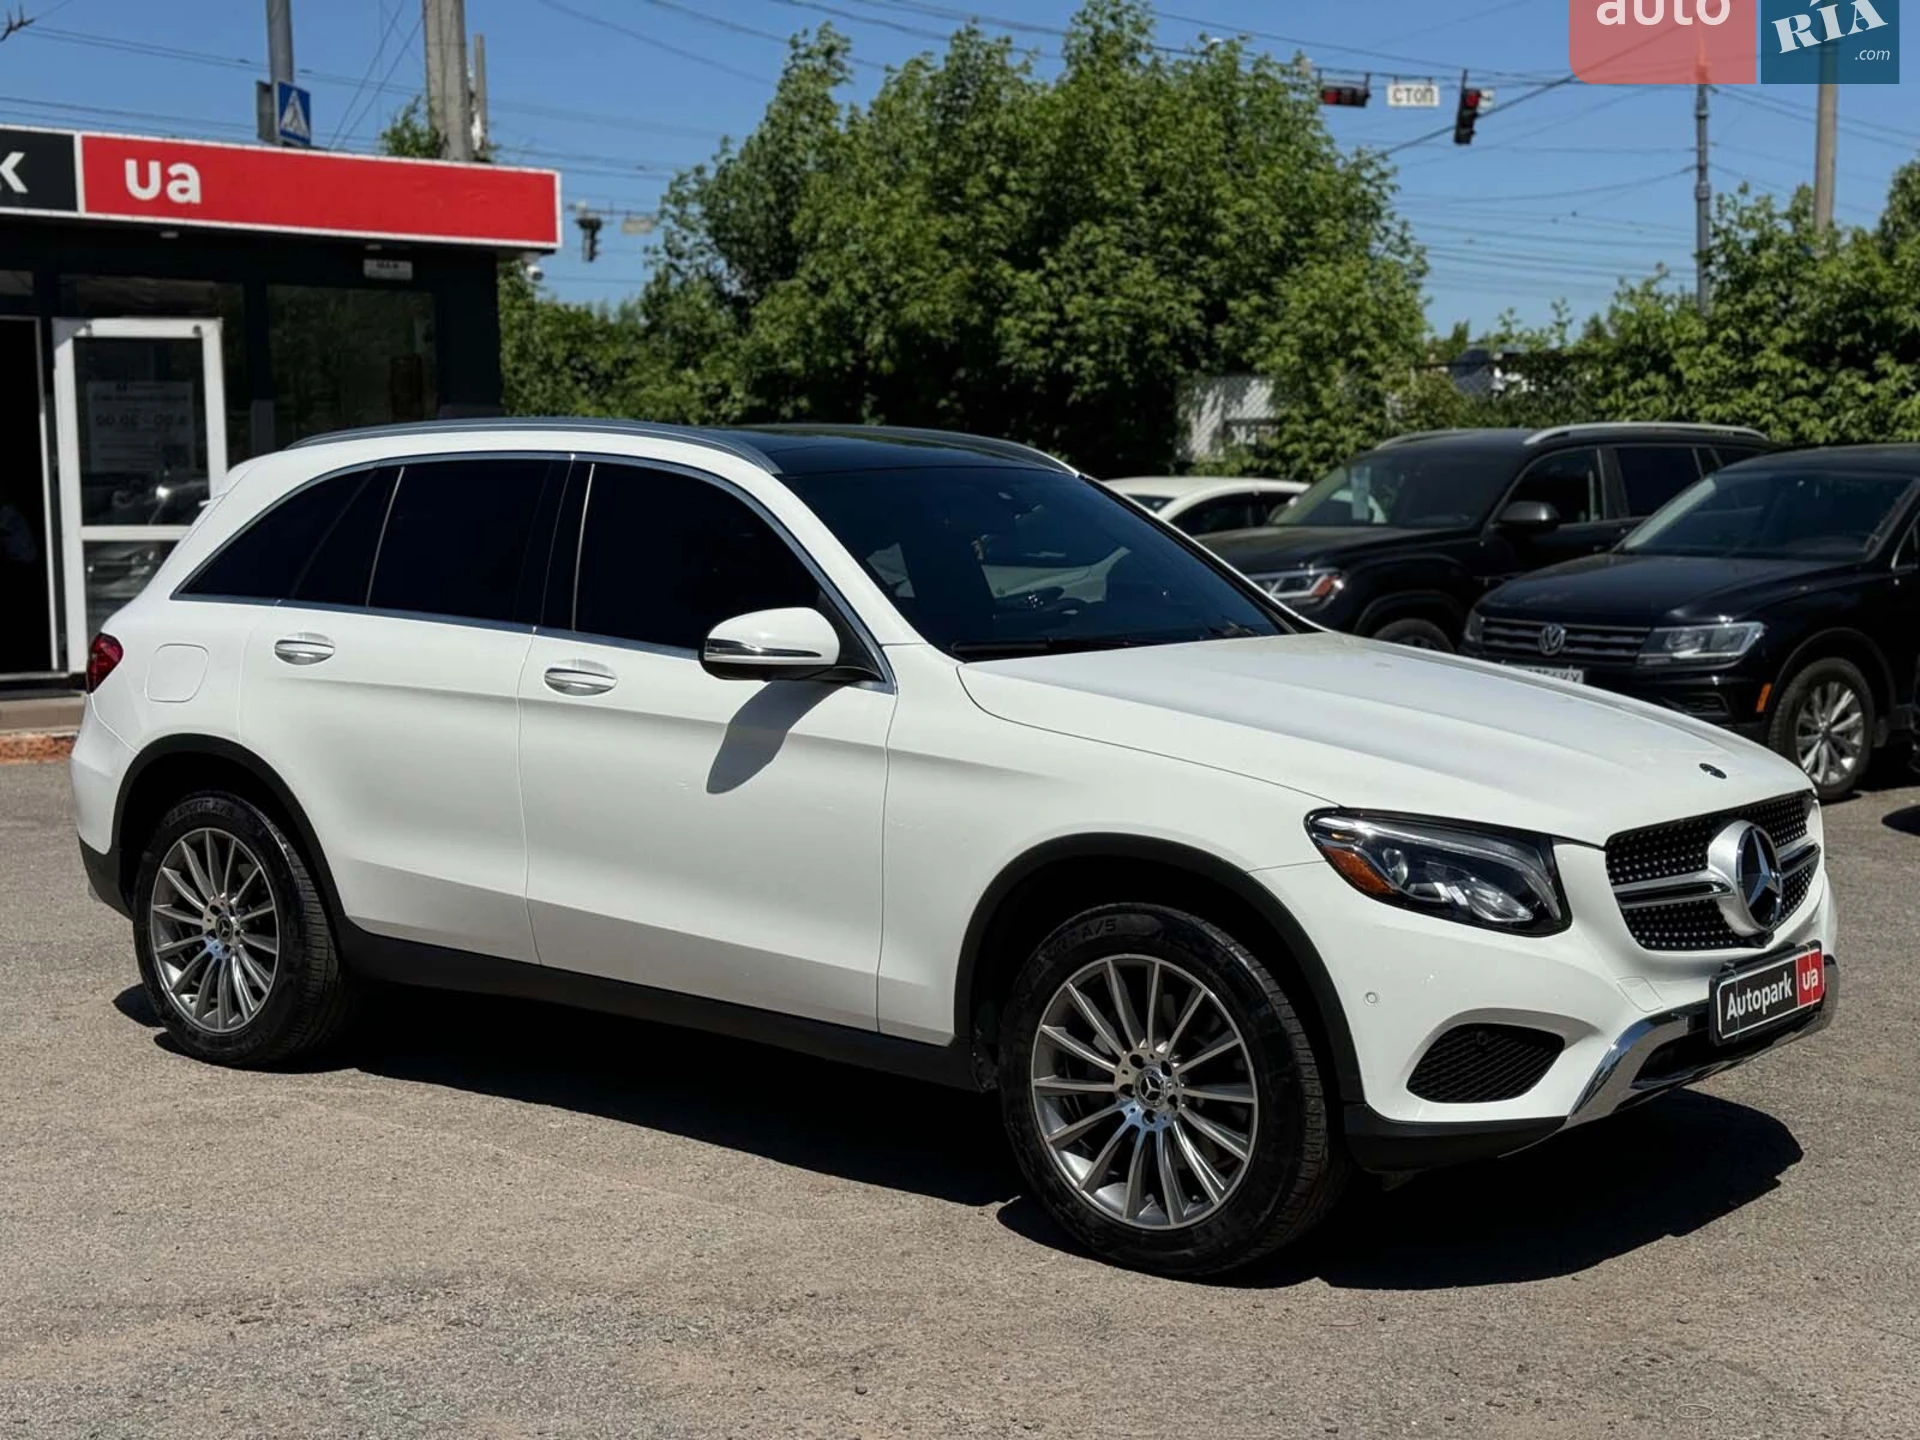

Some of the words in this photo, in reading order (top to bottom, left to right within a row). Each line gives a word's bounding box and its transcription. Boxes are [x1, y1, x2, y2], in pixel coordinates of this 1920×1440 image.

[124, 158, 202, 205] ua
[1726, 971, 1793, 1020] Autopark
[1802, 968, 1819, 991] ua
